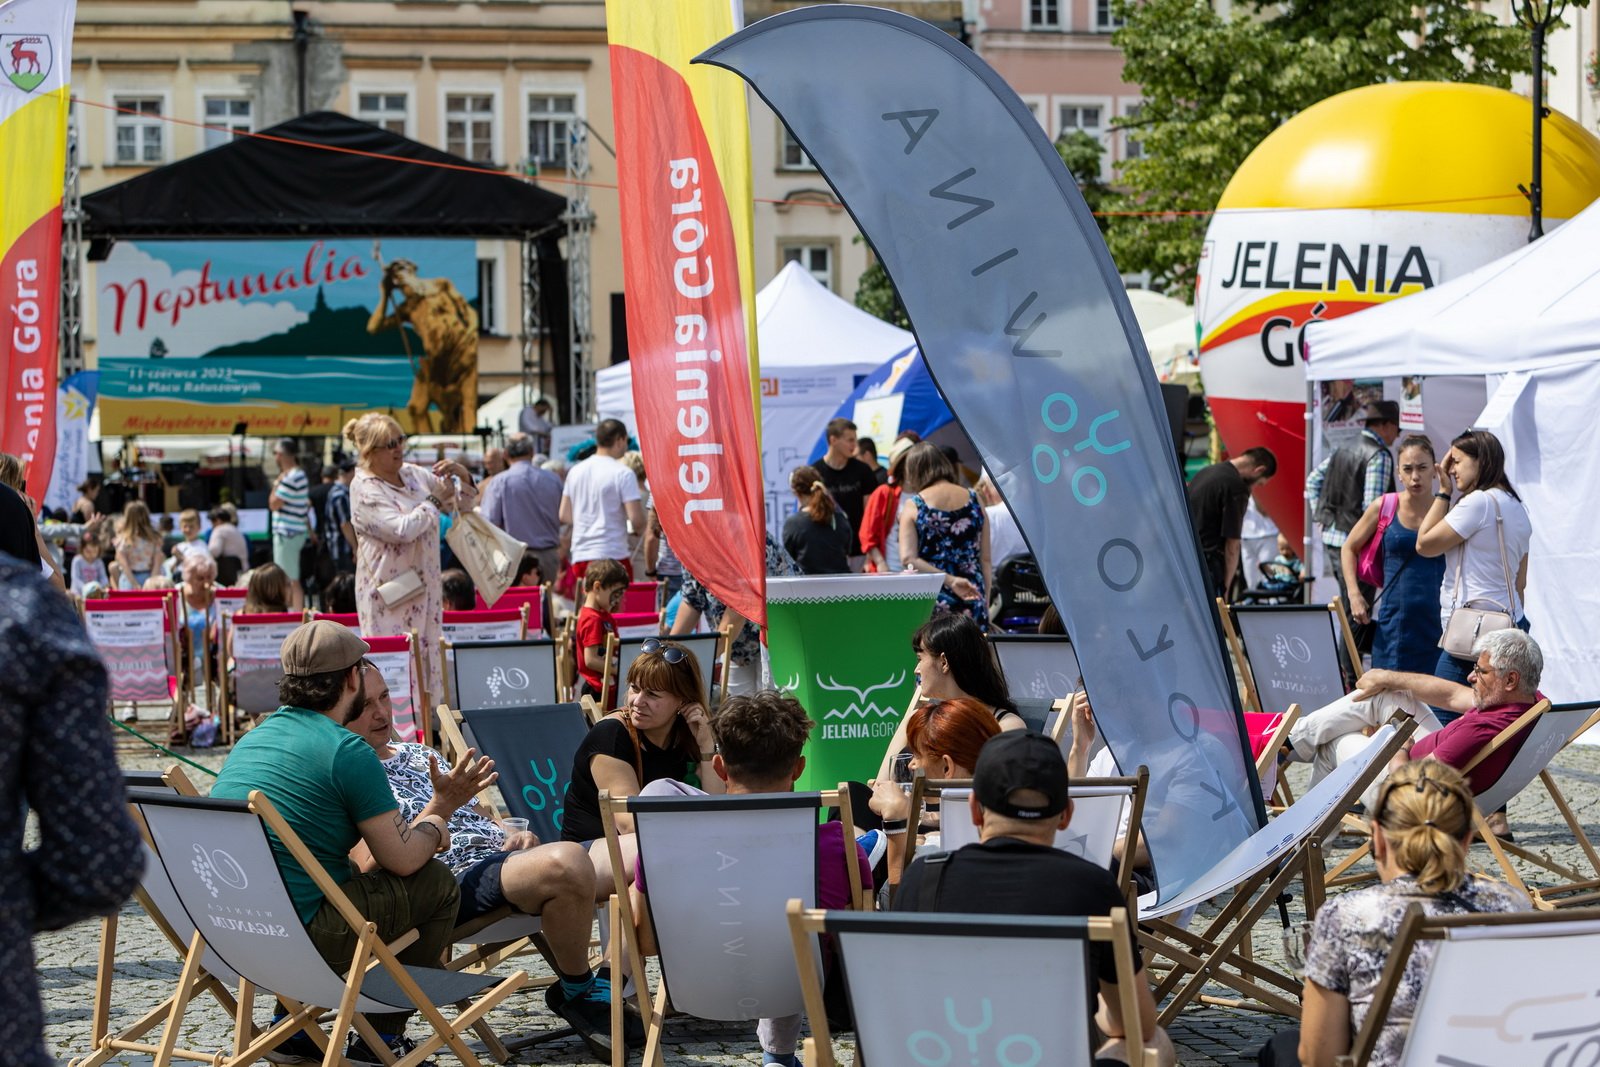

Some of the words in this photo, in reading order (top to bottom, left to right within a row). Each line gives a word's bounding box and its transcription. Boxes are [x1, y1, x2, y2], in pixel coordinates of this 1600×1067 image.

[102, 239, 371, 335] Neptunalia
[1221, 241, 1435, 294] JELENIA
[11, 259, 42, 354] Góra
[127, 383, 144, 393] na
[147, 382, 181, 393] Placu
[820, 723, 869, 740] JELENIA
